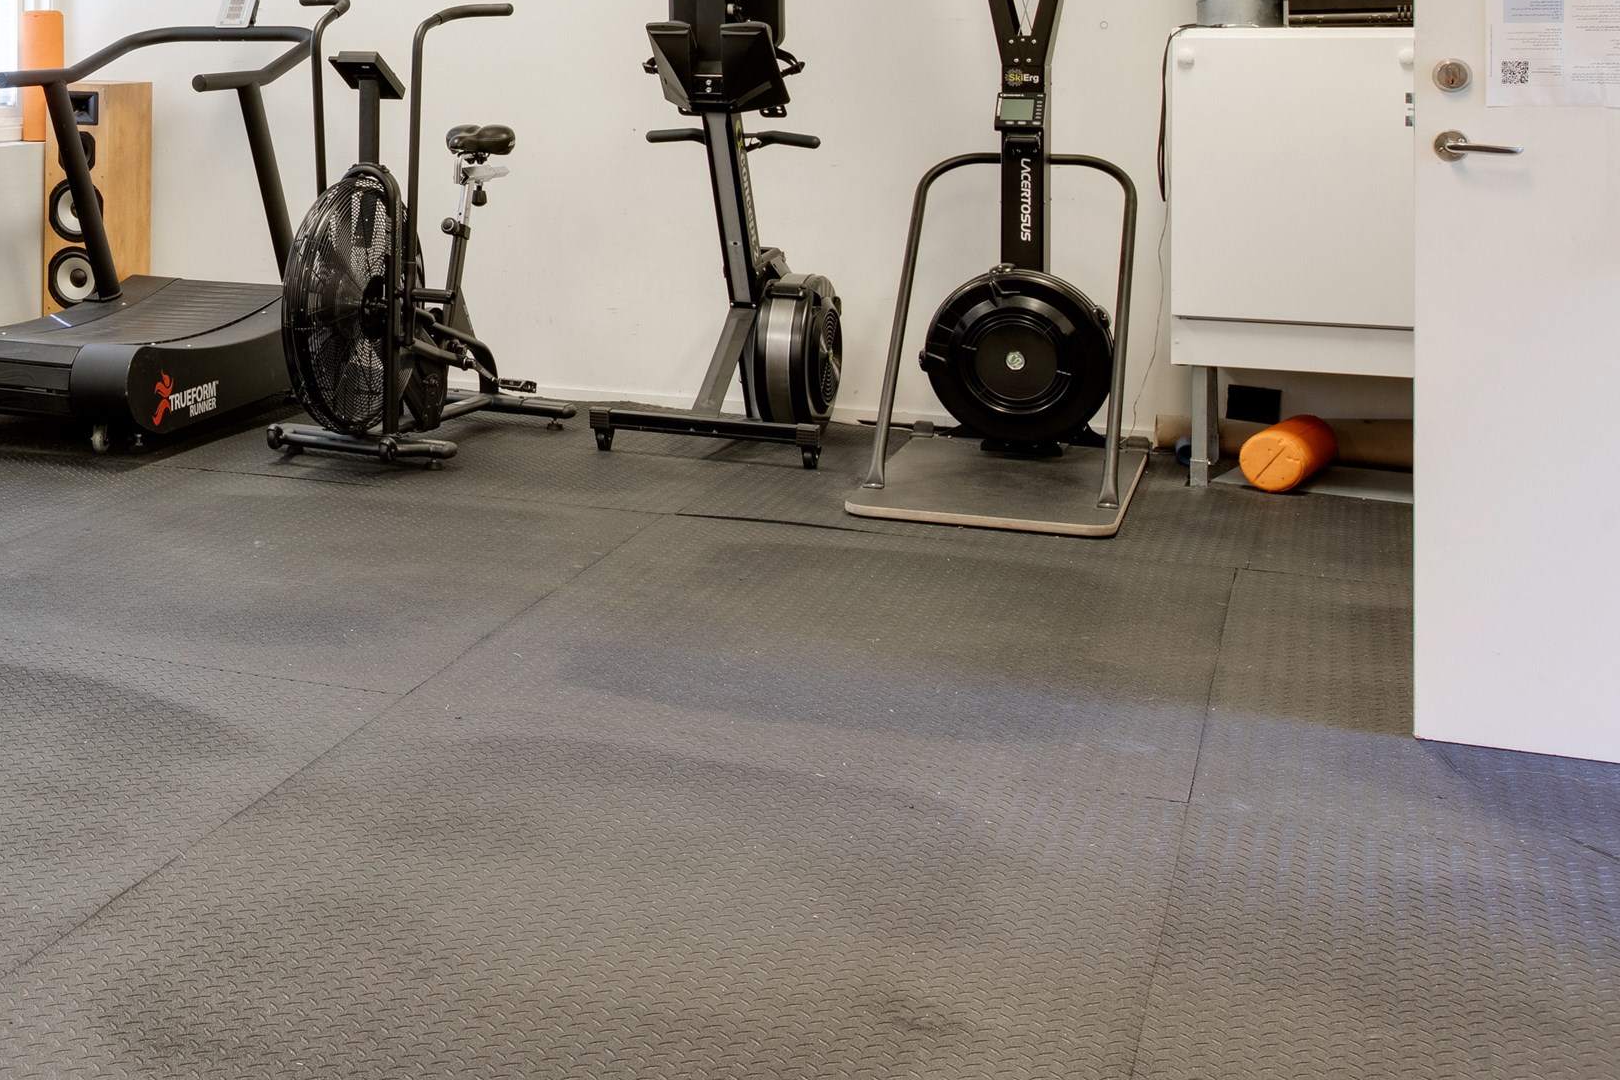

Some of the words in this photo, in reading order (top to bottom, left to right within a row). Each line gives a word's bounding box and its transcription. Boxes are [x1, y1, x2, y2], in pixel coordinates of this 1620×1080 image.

[1009, 73, 1040, 84] SkiErg
[1020, 157, 1032, 242] LACERTOSUS
[168, 381, 217, 412] TRUEFORM
[189, 397, 217, 418] RUNNER
